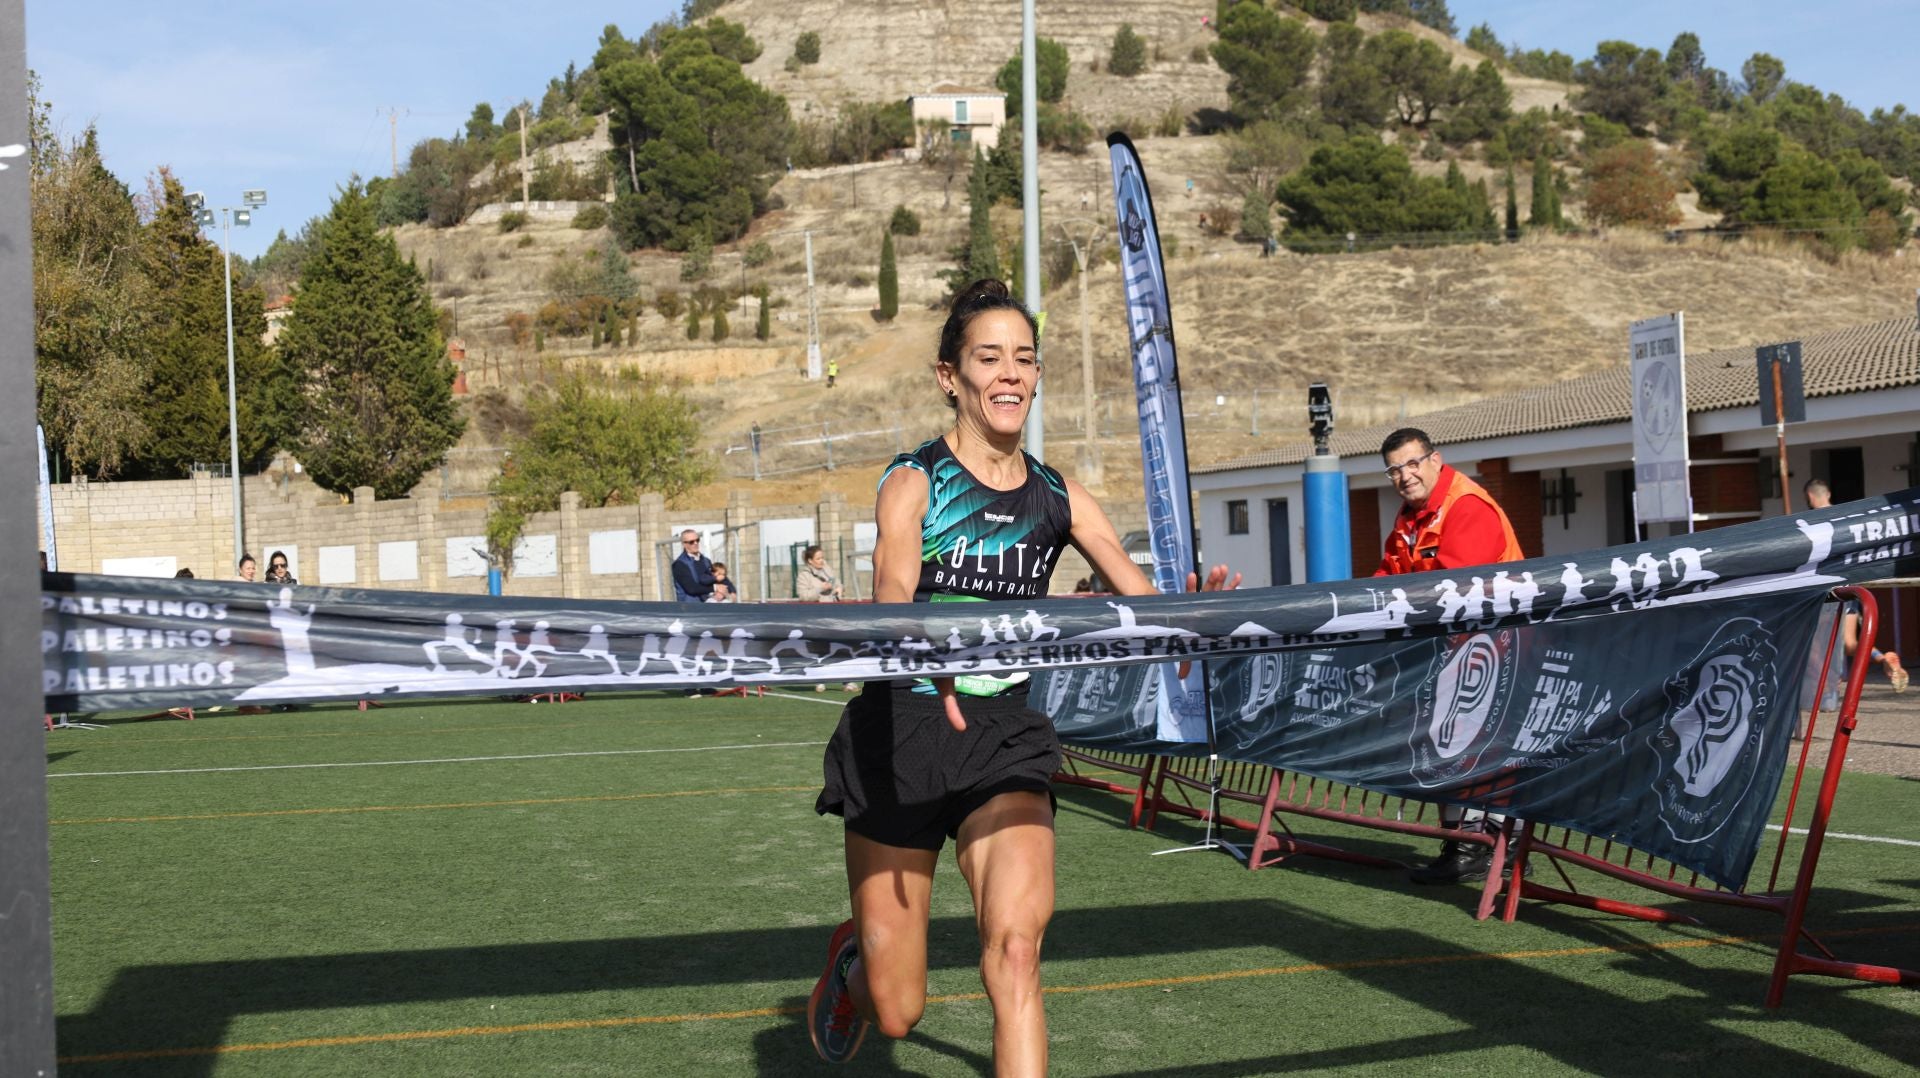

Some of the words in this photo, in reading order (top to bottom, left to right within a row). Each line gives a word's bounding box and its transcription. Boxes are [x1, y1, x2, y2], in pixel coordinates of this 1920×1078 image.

[1849, 514, 1920, 543] TRAIL
[935, 571, 1037, 595] BALMATRAIL
[41, 595, 228, 620] PALETINOS
[41, 628, 232, 652] PALETINOS
[42, 661, 235, 692] PALETINOS
